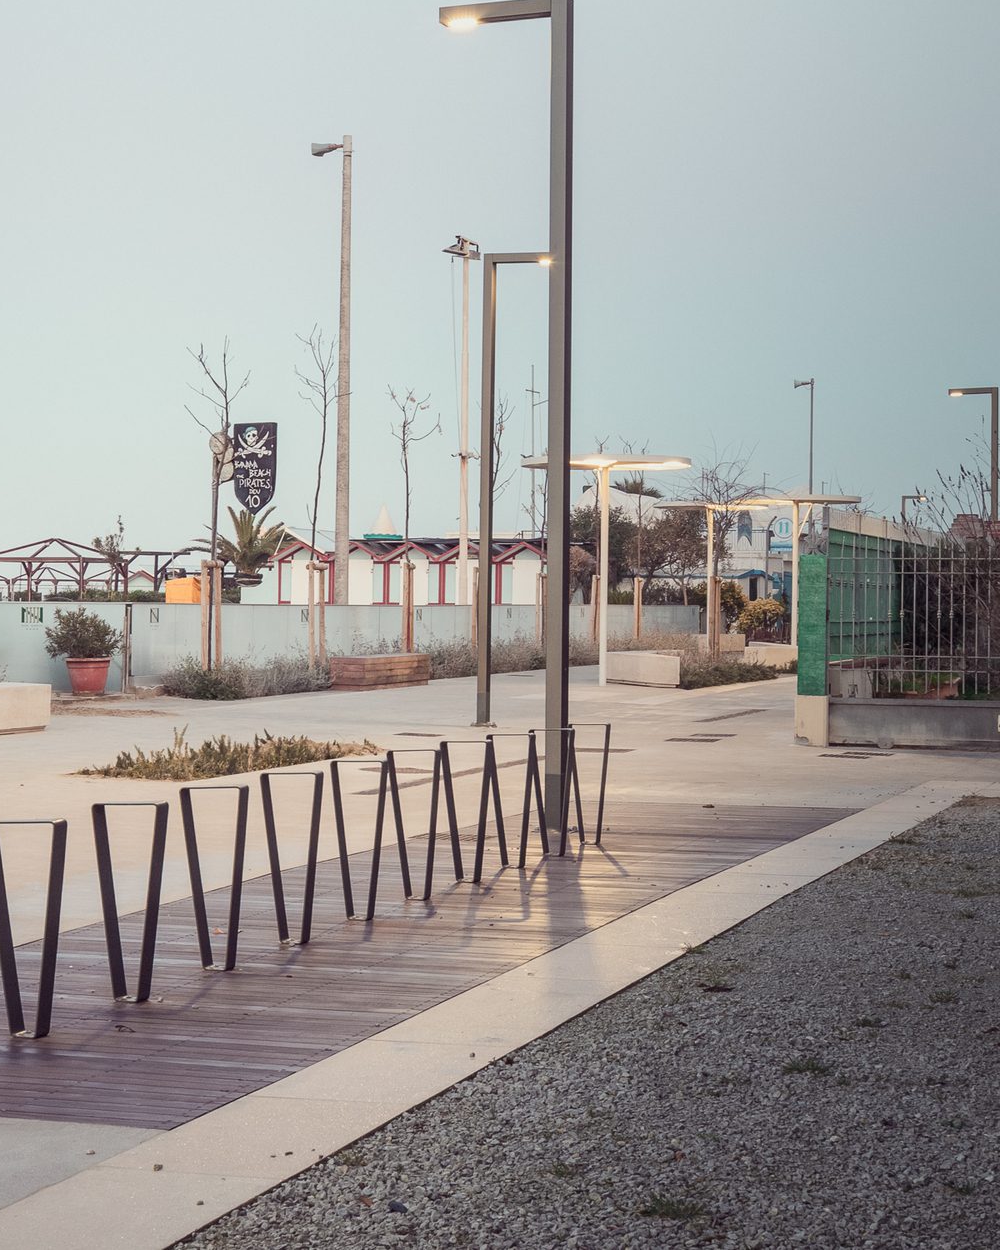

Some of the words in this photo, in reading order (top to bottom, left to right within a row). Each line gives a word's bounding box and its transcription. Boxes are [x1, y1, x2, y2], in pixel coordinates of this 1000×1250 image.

[249, 469, 271, 478] BEACH
[239, 478, 271, 489] PIRATES
[245, 494, 261, 508] 10
